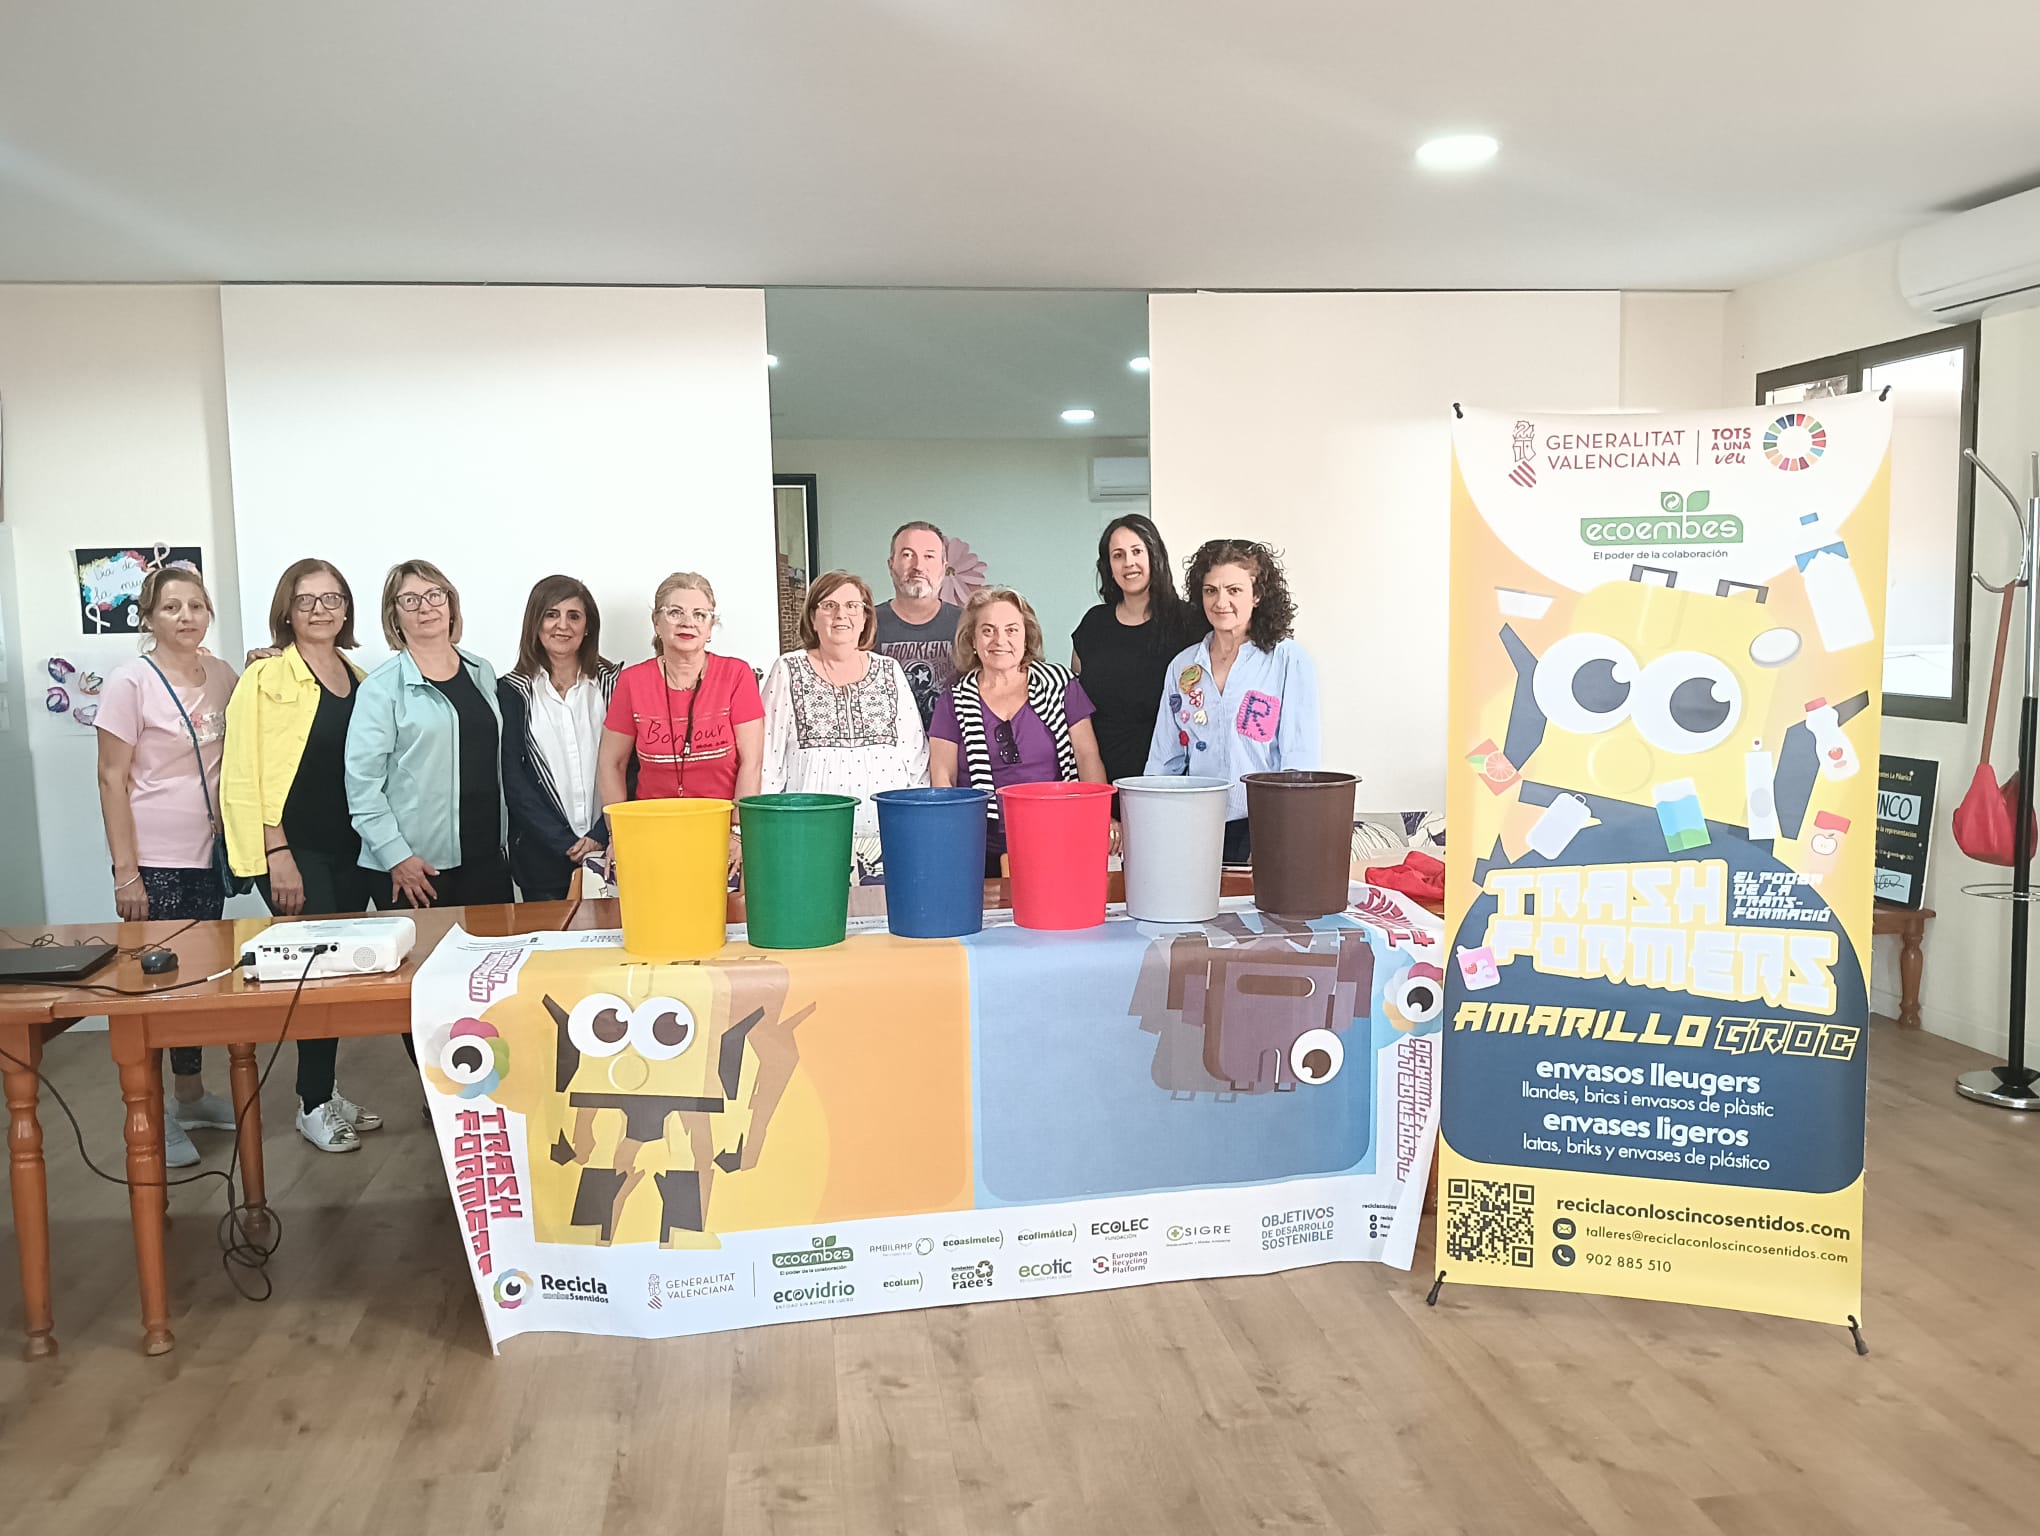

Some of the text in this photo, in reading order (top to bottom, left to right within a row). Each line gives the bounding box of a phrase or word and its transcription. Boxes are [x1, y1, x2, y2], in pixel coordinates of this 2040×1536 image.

[1547, 430, 1685, 451] GENERALITAT
[1711, 427, 1752, 441] TOTS
[1711, 441, 1752, 451] A UNA
[1547, 451, 1681, 471] VALENCIANA
[1715, 449, 1746, 465] veu
[1585, 517, 1738, 542] ecoembes
[1593, 549, 1729, 561] El poder de la colaboración
[1241, 696, 1271, 736] R
[645, 720, 726, 746] Bonour
[1878, 793, 1913, 821] NCO
[1733, 871, 1824, 886] EL PODER
[1490, 866, 1723, 924] TRASH
[1733, 883, 1792, 897] DE LA
[1733, 895, 1804, 909] TRANS-
[1732, 906, 1832, 923] FORMACIÓ
[1489, 920, 1833, 1009] FORMERS
[1452, 1000, 1713, 1048] AMARILLO
[1713, 1016, 1861, 1061] GROC
[1535, 1060, 1761, 1096] envasos lleugers
[1521, 1081, 1775, 1118] llandes, brics i envasos de plàstic
[1543, 1113, 1749, 1147] envases ligeros
[1523, 1133, 1771, 1170] latas, briks y envases de plástico
[481, 1107, 523, 1220] TRASH
[1091, 1217, 1149, 1236] ECOLEC
[1261, 1206, 1335, 1228] OBJETIVOS
[1556, 1198, 1851, 1241] reciclaconloscincosentidos.com
[1018, 1227, 1074, 1241] ecofimática
[1184, 1224, 1231, 1237] SIGRE
[1261, 1220, 1334, 1240] DE DESARROLLO
[1262, 1229, 1334, 1251] SOSTENIBLE
[943, 1234, 1001, 1248] ecoasimelec
[1585, 1226, 1849, 1264] talleres@reciclaconloscincosentidos.com
[774, 1249, 851, 1267] ecoembes
[1112, 1250, 1148, 1260] European
[1112, 1257, 1148, 1268] Recycling
[1585, 1252, 1672, 1273] 902 885 510
[951, 1271, 975, 1281] eco
[1018, 1258, 1072, 1278] ecotic
[1112, 1264, 1146, 1274] Platform
[540, 1274, 608, 1295] Recicla
[665, 1271, 737, 1290] GENERALITAT
[883, 1276, 920, 1289] ecolum
[667, 1284, 735, 1300] VALENCIANA
[773, 1280, 855, 1303] ecovidrio
